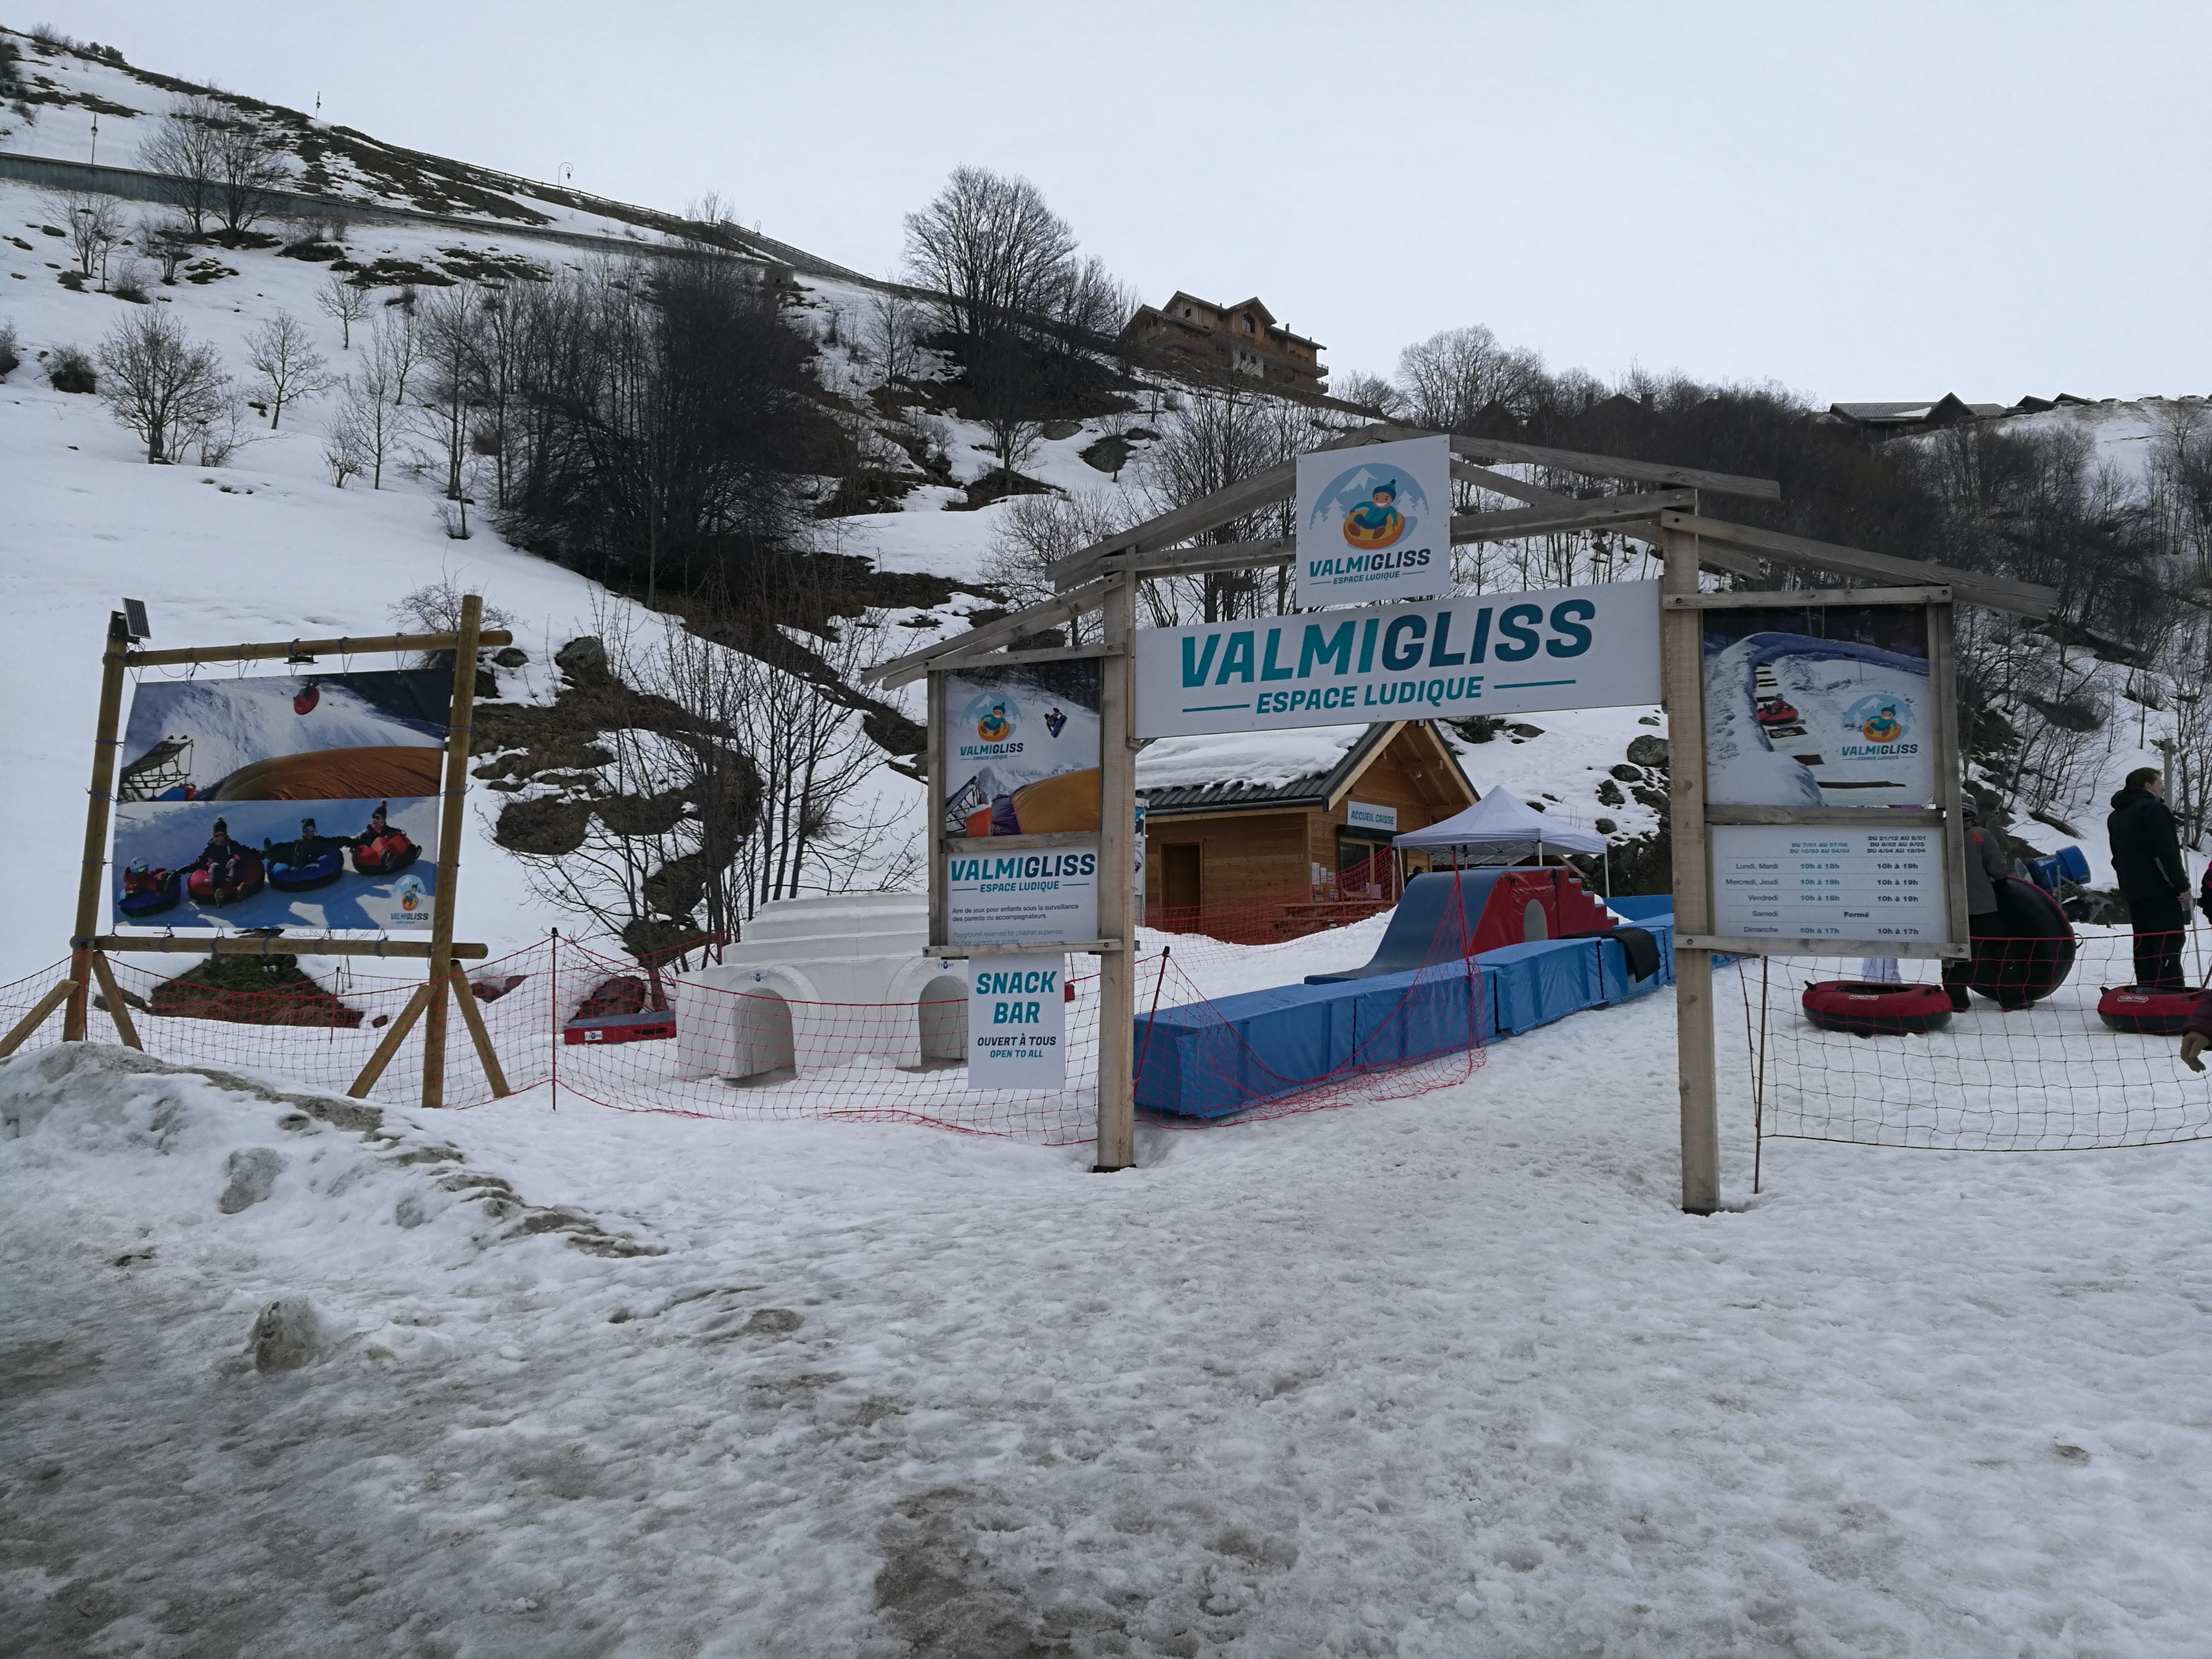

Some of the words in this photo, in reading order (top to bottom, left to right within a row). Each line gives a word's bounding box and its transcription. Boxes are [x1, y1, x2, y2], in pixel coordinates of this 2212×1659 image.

[1309, 549, 1431, 577] VALMIGLISS
[1333, 575, 1364, 584] ESPACE
[1365, 571, 1400, 581] LUDIQUE
[1181, 598, 1596, 688] VALMIGLISS
[1257, 685, 1356, 714] ESPACE
[1364, 676, 1485, 707] LUDIQUE
[960, 743, 1023, 756] VALMIGLISS
[1842, 744, 1918, 756] VALMIGLISS
[1351, 811, 1374, 822] ACCUEIL
[1375, 814, 1394, 824] CAISSE
[951, 853, 1095, 881] VALMIGLISS
[980, 882, 1016, 892] ESPACE
[1018, 881, 1060, 892] LUDIQUE
[976, 971, 1057, 995] SNACK
[993, 1002, 1040, 1023] BAR
[977, 1037, 1017, 1046] OUVERT
[1019, 1033, 1025, 1046] À
[1029, 1036, 1056, 1046] TOUS
